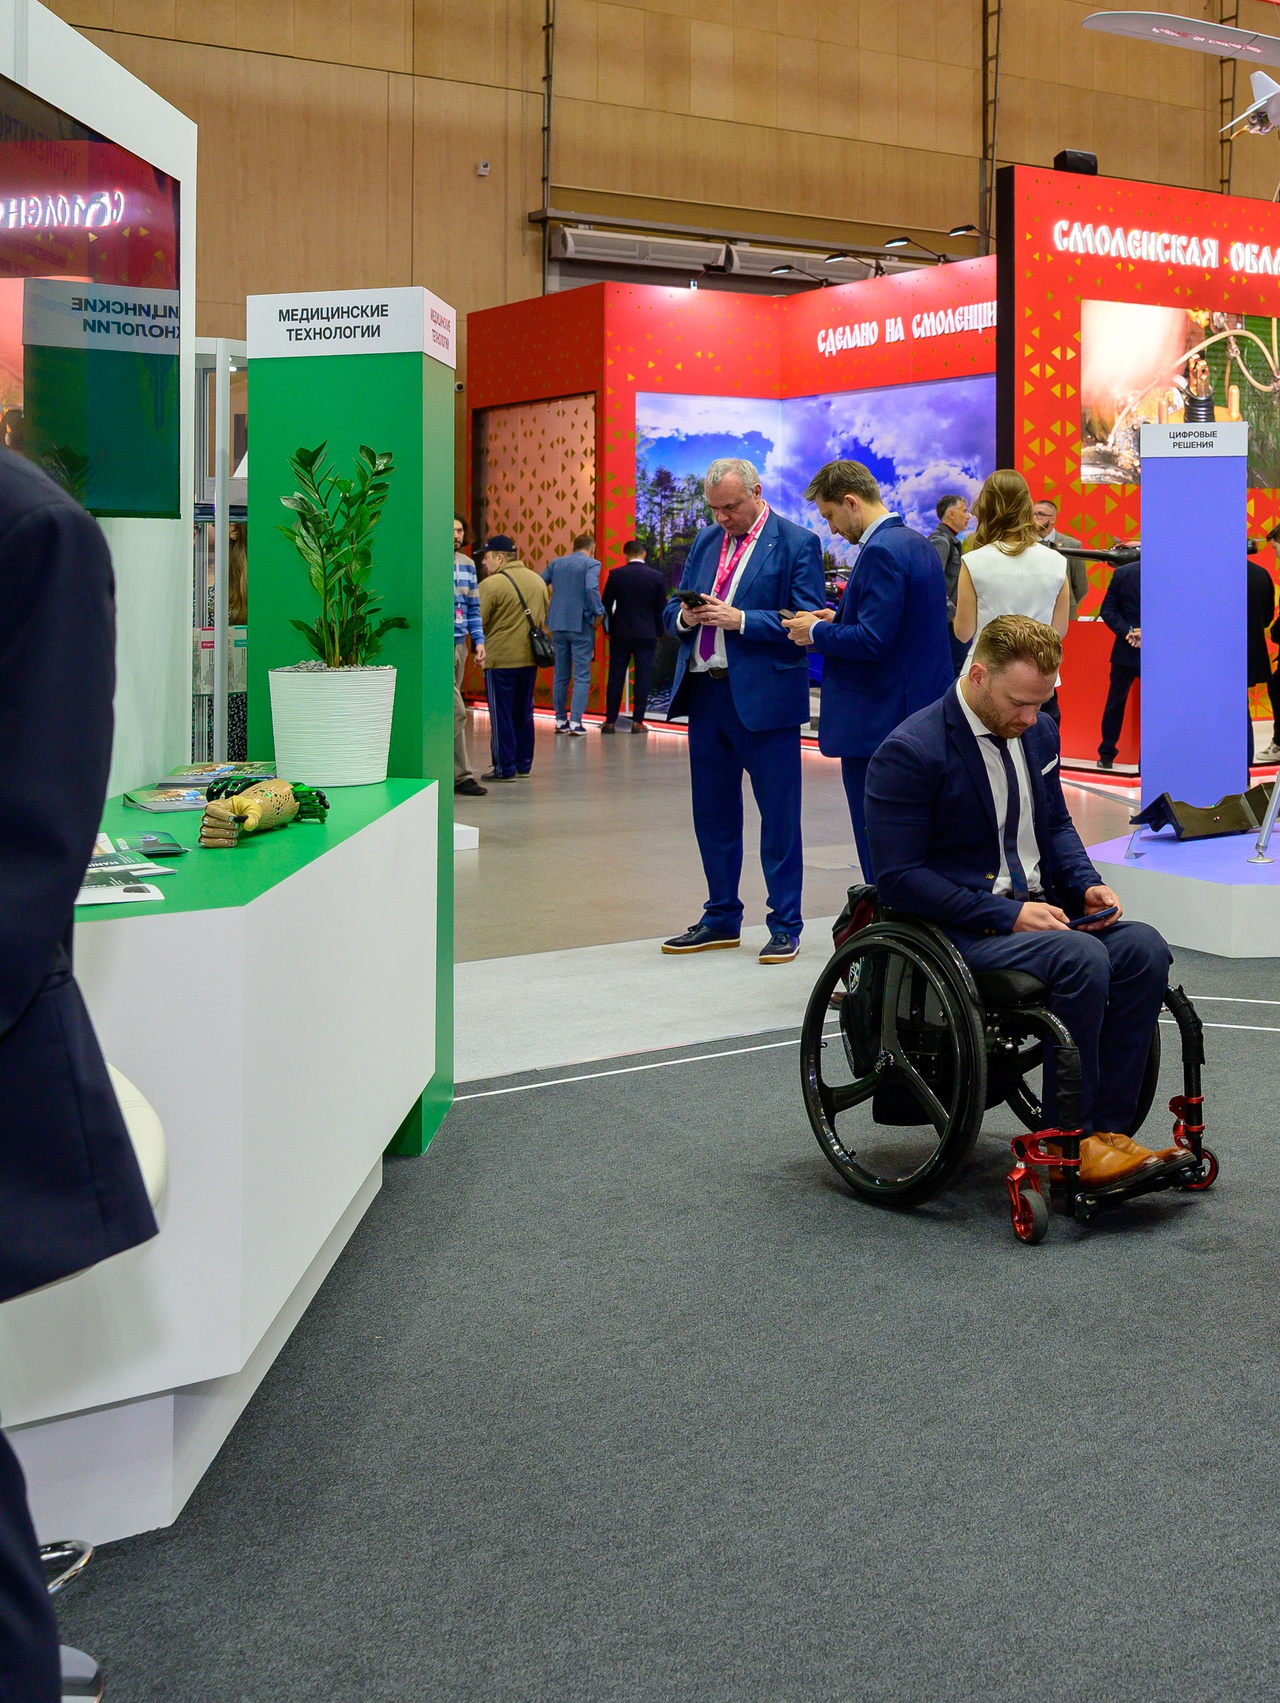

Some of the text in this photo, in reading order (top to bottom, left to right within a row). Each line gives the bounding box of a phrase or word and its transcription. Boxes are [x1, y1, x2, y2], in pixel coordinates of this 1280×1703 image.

[1053, 220, 1219, 268] СМОЛЕНСКАЯ
[278, 304, 389, 323] МЕДИЦИНСКИЕ
[286, 324, 381, 341] ТЕХНОЛОГИИ
[817, 321, 878, 357] СДЕЛАНО
[885, 316, 905, 343] НА
[1168, 430, 1218, 439] ЦИФРОВЫЕ
[1172, 441, 1214, 449] РЕШЕНИЯ
